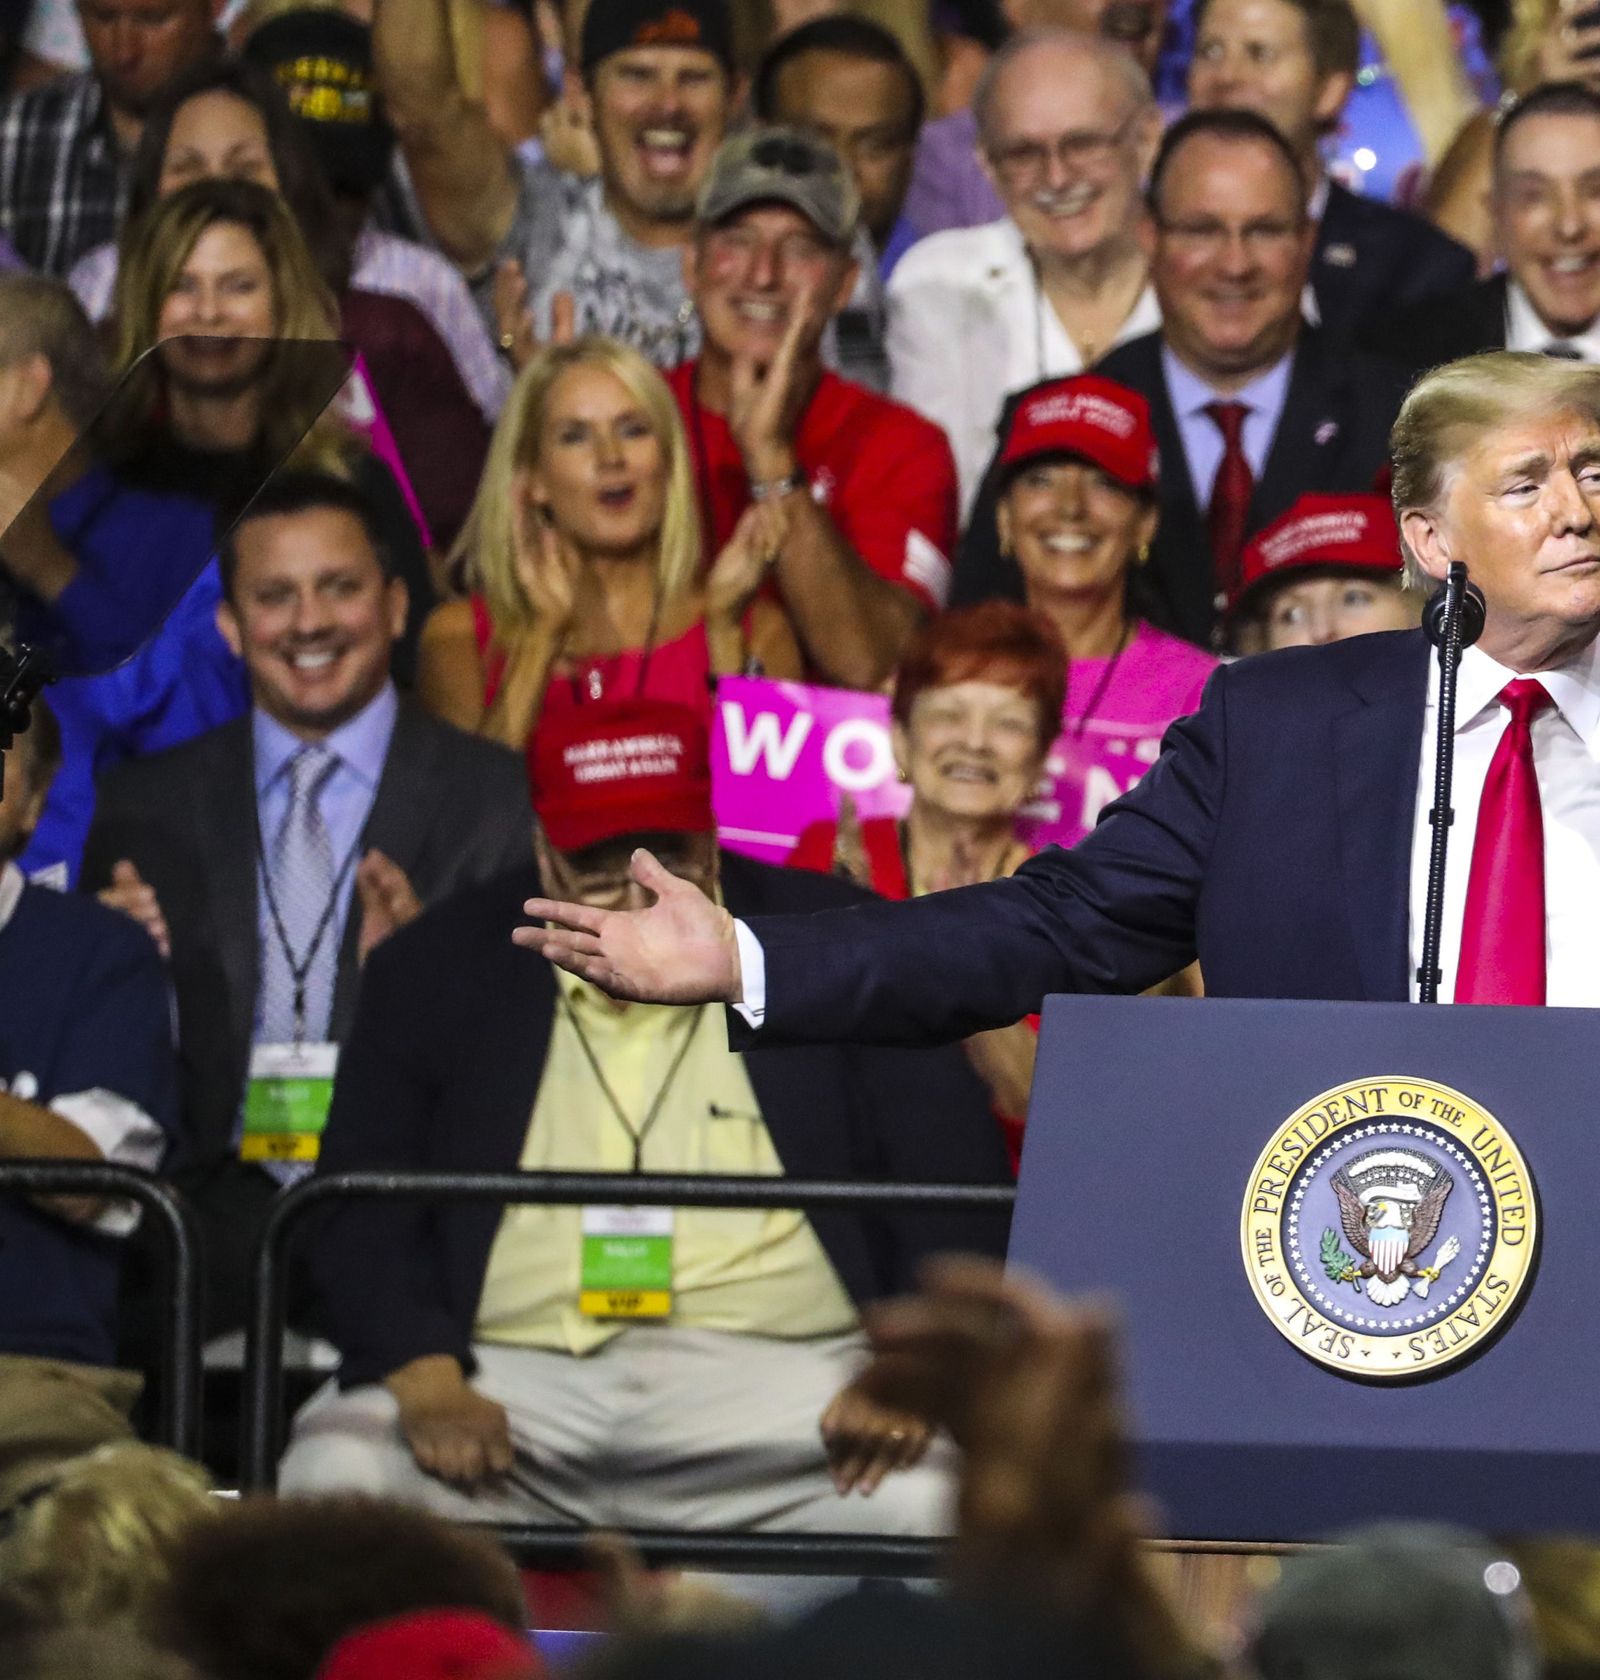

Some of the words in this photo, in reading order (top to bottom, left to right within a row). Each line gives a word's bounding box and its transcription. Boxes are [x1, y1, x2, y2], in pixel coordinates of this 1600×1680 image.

[1398, 1091, 1425, 1110] OF
[1431, 1098, 1466, 1128] THE
[1253, 1088, 1389, 1216] PRESIDENT
[1470, 1124, 1526, 1247] UNITED
[1255, 1227, 1275, 1268] THE
[1264, 1273, 1286, 1297] OF
[1284, 1298, 1355, 1359] SEAL
[1408, 1272, 1511, 1361] STATES
